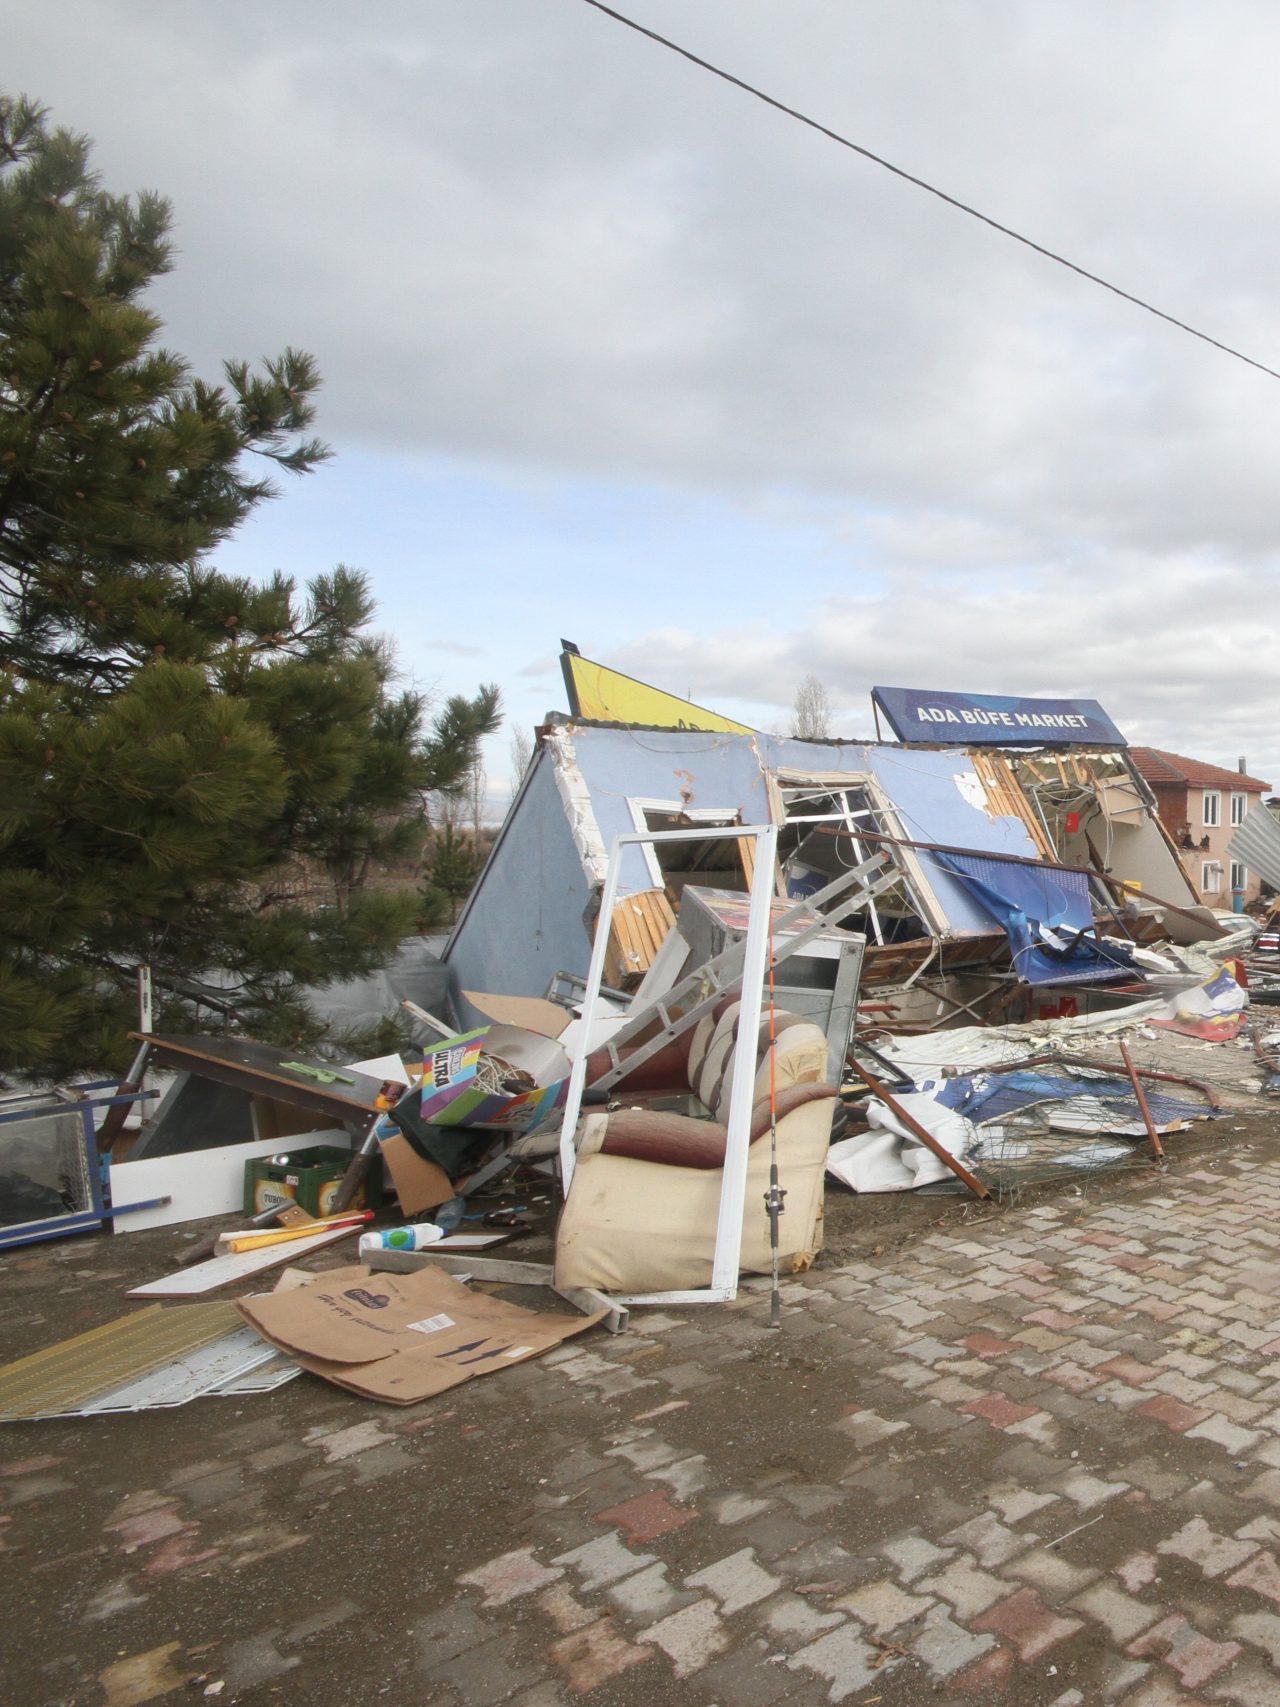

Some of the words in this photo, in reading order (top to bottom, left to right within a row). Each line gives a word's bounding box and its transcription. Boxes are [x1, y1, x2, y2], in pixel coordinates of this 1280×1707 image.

[917, 707, 962, 724] ADA
[960, 708, 1015, 726] BÜFE
[1014, 713, 1089, 729] MARKET
[433, 1050, 452, 1089] ULTRA
